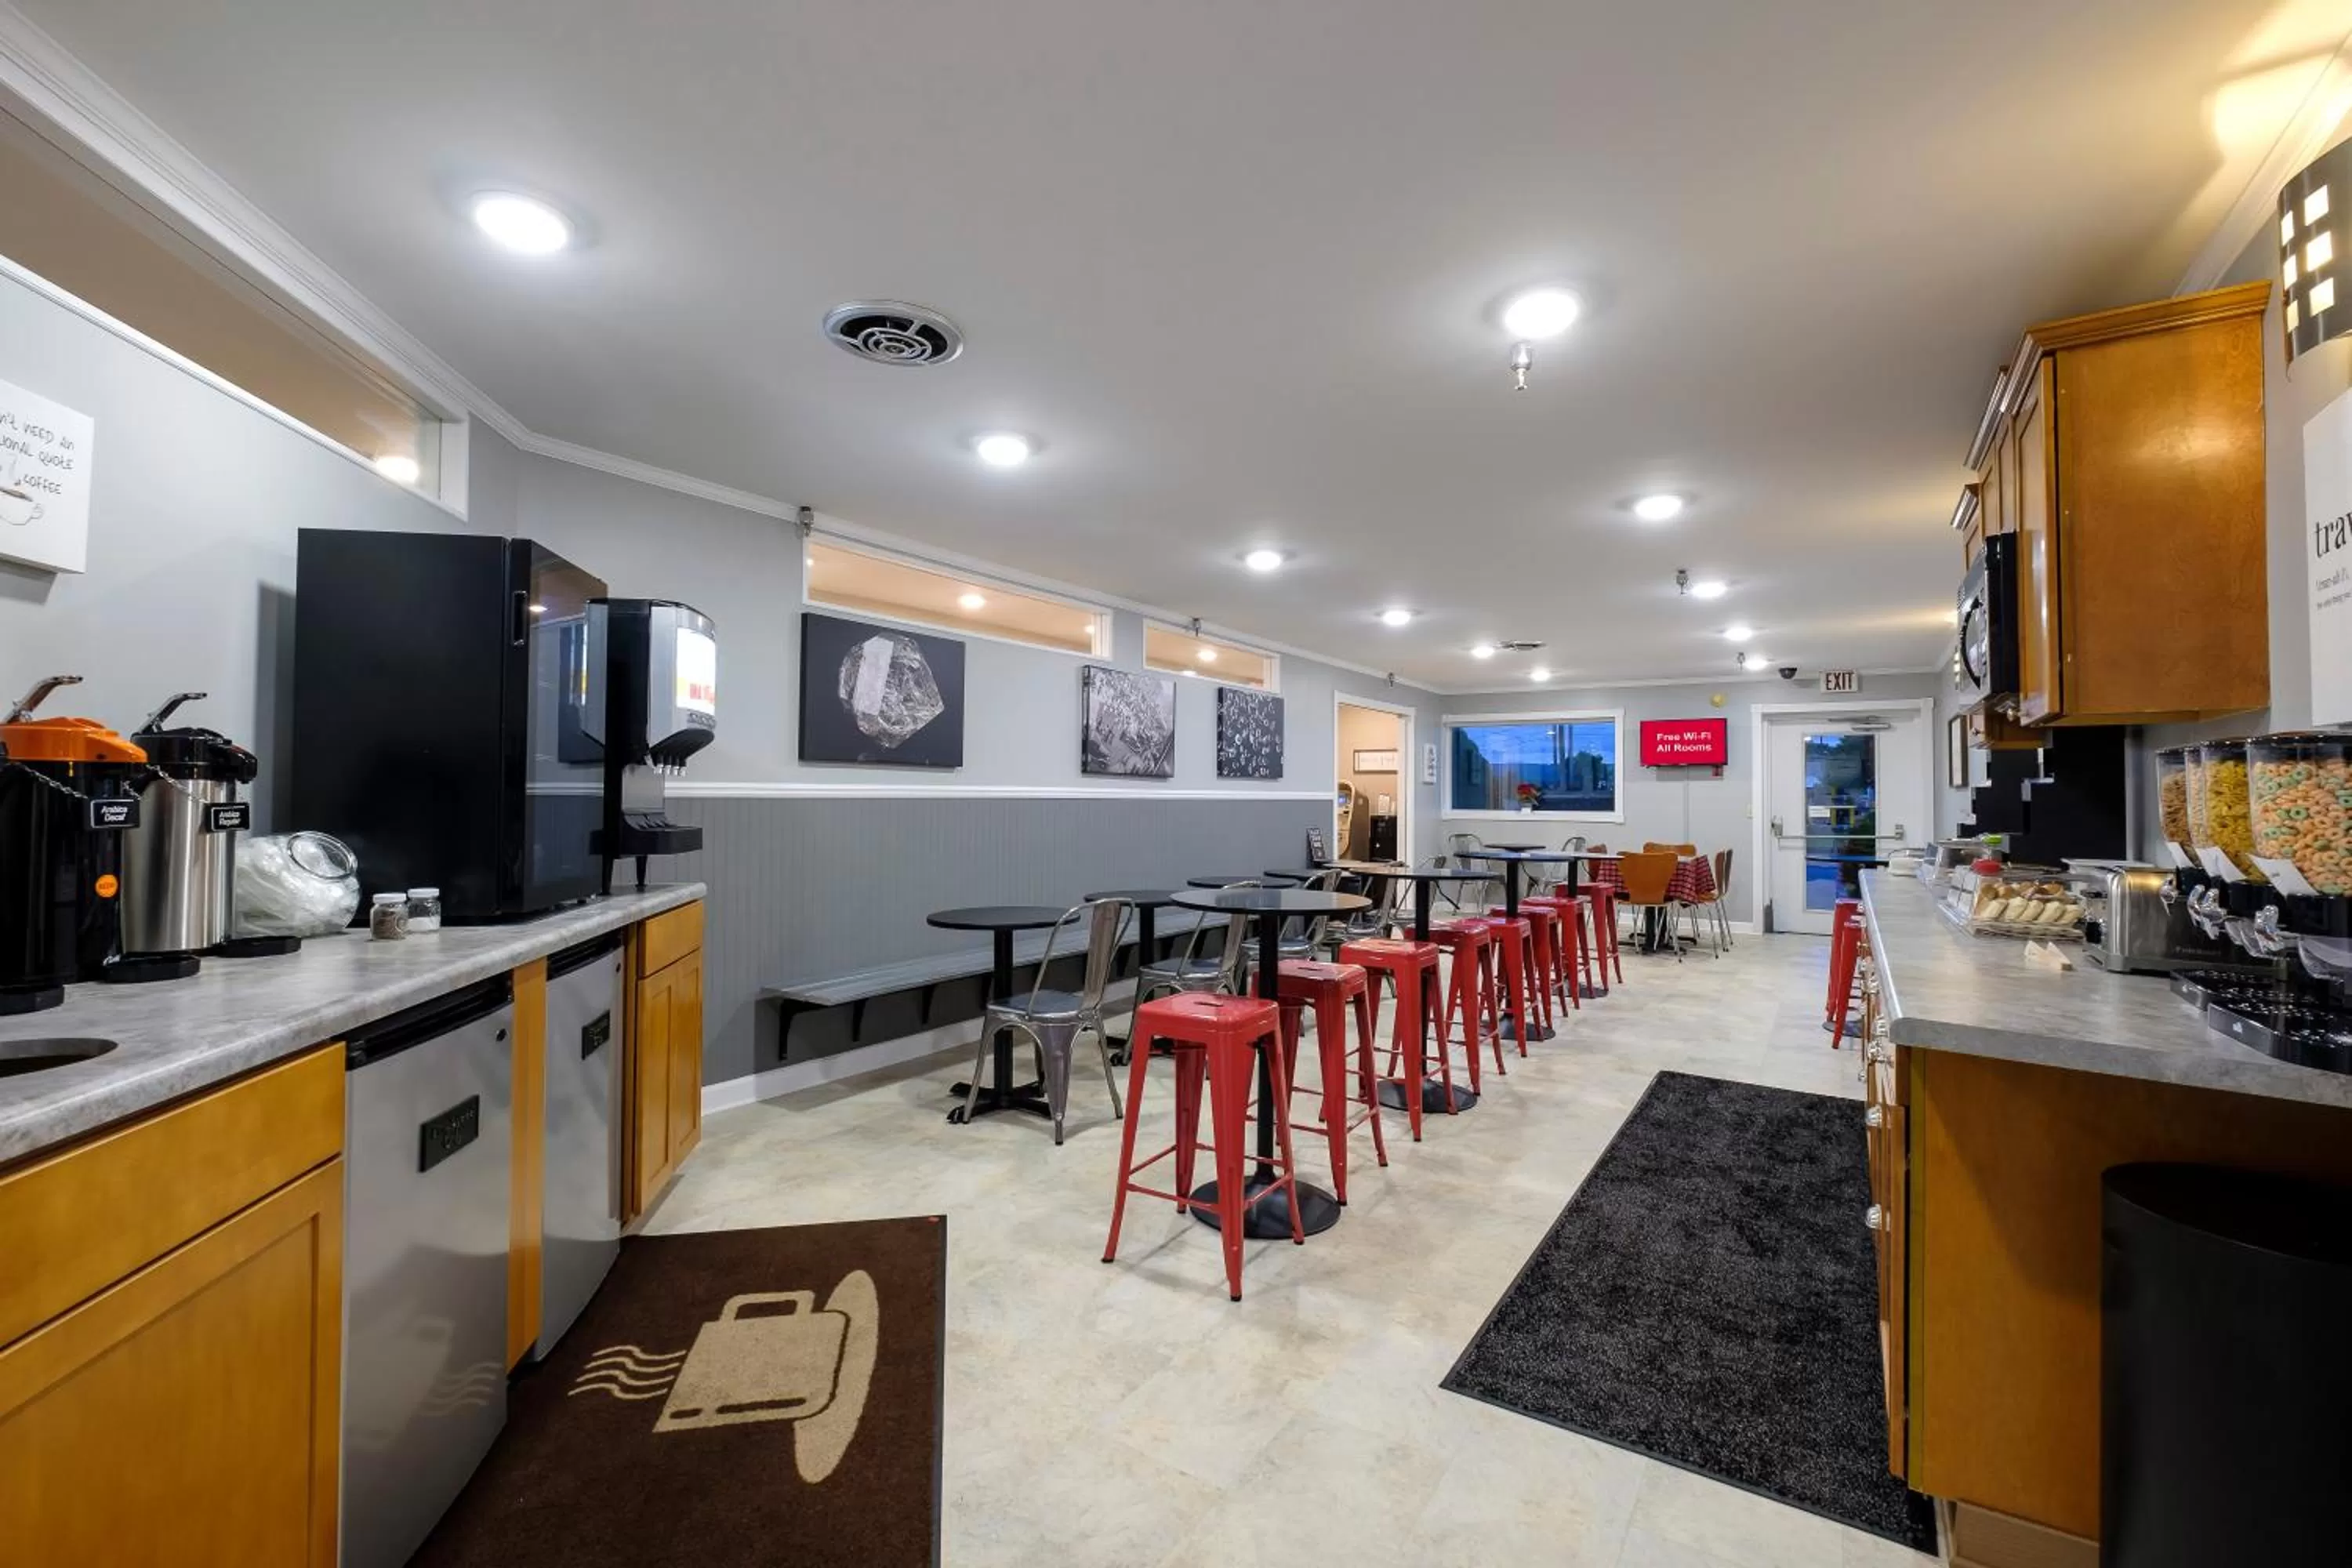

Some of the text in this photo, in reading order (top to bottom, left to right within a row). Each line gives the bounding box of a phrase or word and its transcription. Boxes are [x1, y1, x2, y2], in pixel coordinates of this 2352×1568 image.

[23, 474, 62, 495] COFFEE
[1825, 672, 1855, 691] EXIT
[1683, 731, 1712, 741] Wi-Fi
[1657, 743, 1712, 753] All Rooms
